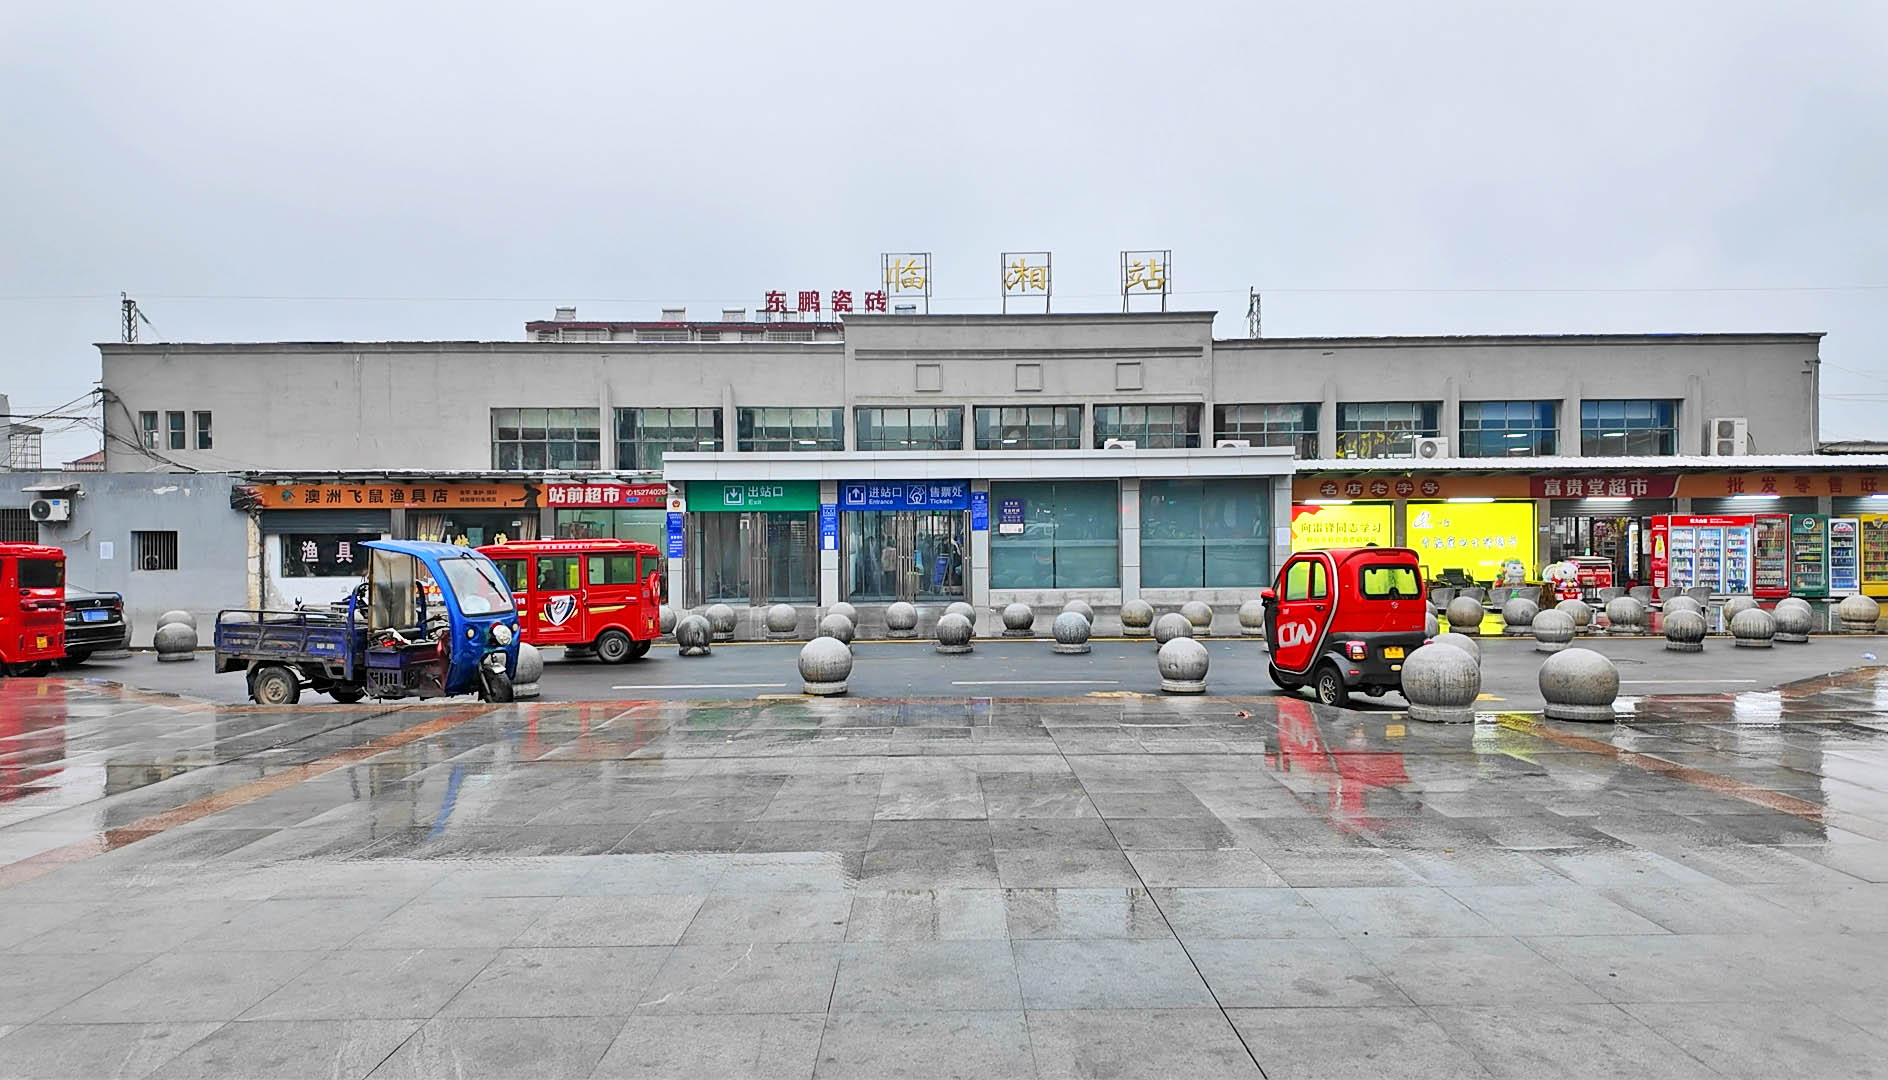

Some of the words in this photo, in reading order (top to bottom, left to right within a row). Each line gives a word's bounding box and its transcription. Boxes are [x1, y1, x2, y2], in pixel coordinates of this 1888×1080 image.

[887, 258, 1166, 293] 临湘站
[765, 290, 888, 313] 东鹏瓷砖
[747, 485, 783, 498] 出站口
[868, 487, 902, 498] 进站口
[930, 486, 963, 498] 售票处
[1321, 482, 1440, 496] 名店老字号
[1543, 478, 1649, 496] 富贵堂超市
[1727, 476, 1878, 494] 批发零售旺
[304, 488, 448, 504] 澳洲飞鼠渔具店
[548, 487, 621, 504] 站前超市
[301, 540, 353, 564] 渔具
